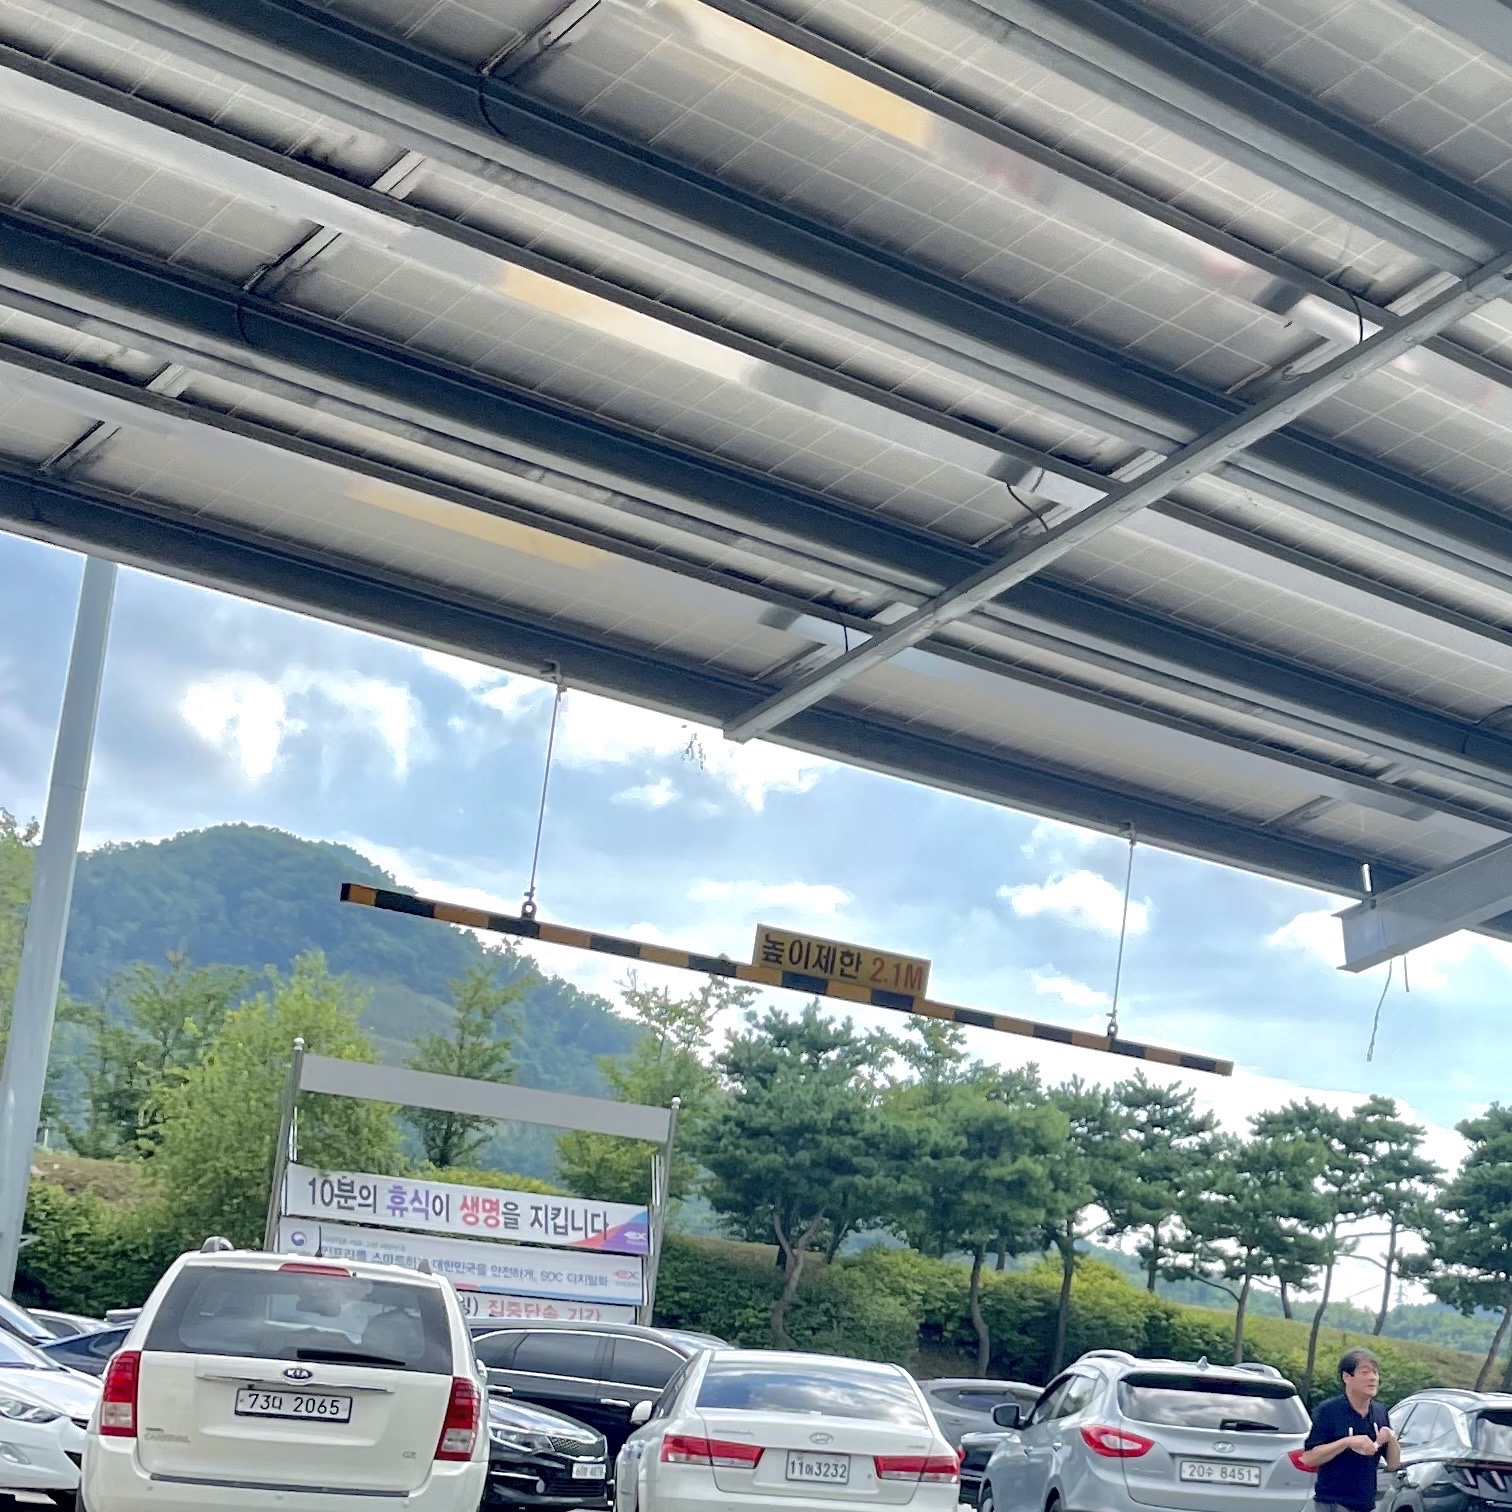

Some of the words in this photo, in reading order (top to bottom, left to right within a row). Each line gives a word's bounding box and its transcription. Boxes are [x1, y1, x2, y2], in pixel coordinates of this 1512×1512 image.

[761, 933, 863, 980] 높이제한
[869, 956, 923, 992] 2.1M
[308, 1175, 377, 1214] 10분의
[387, 1184, 450, 1223] 휴식이
[459, 1194, 521, 1231] 생명을
[530, 1204, 609, 1241] 지킵니다
[540, 1269, 564, 1283] SOC
[293, 1396, 340, 1415] 2065
[1220, 1466, 1252, 1481] 8451
